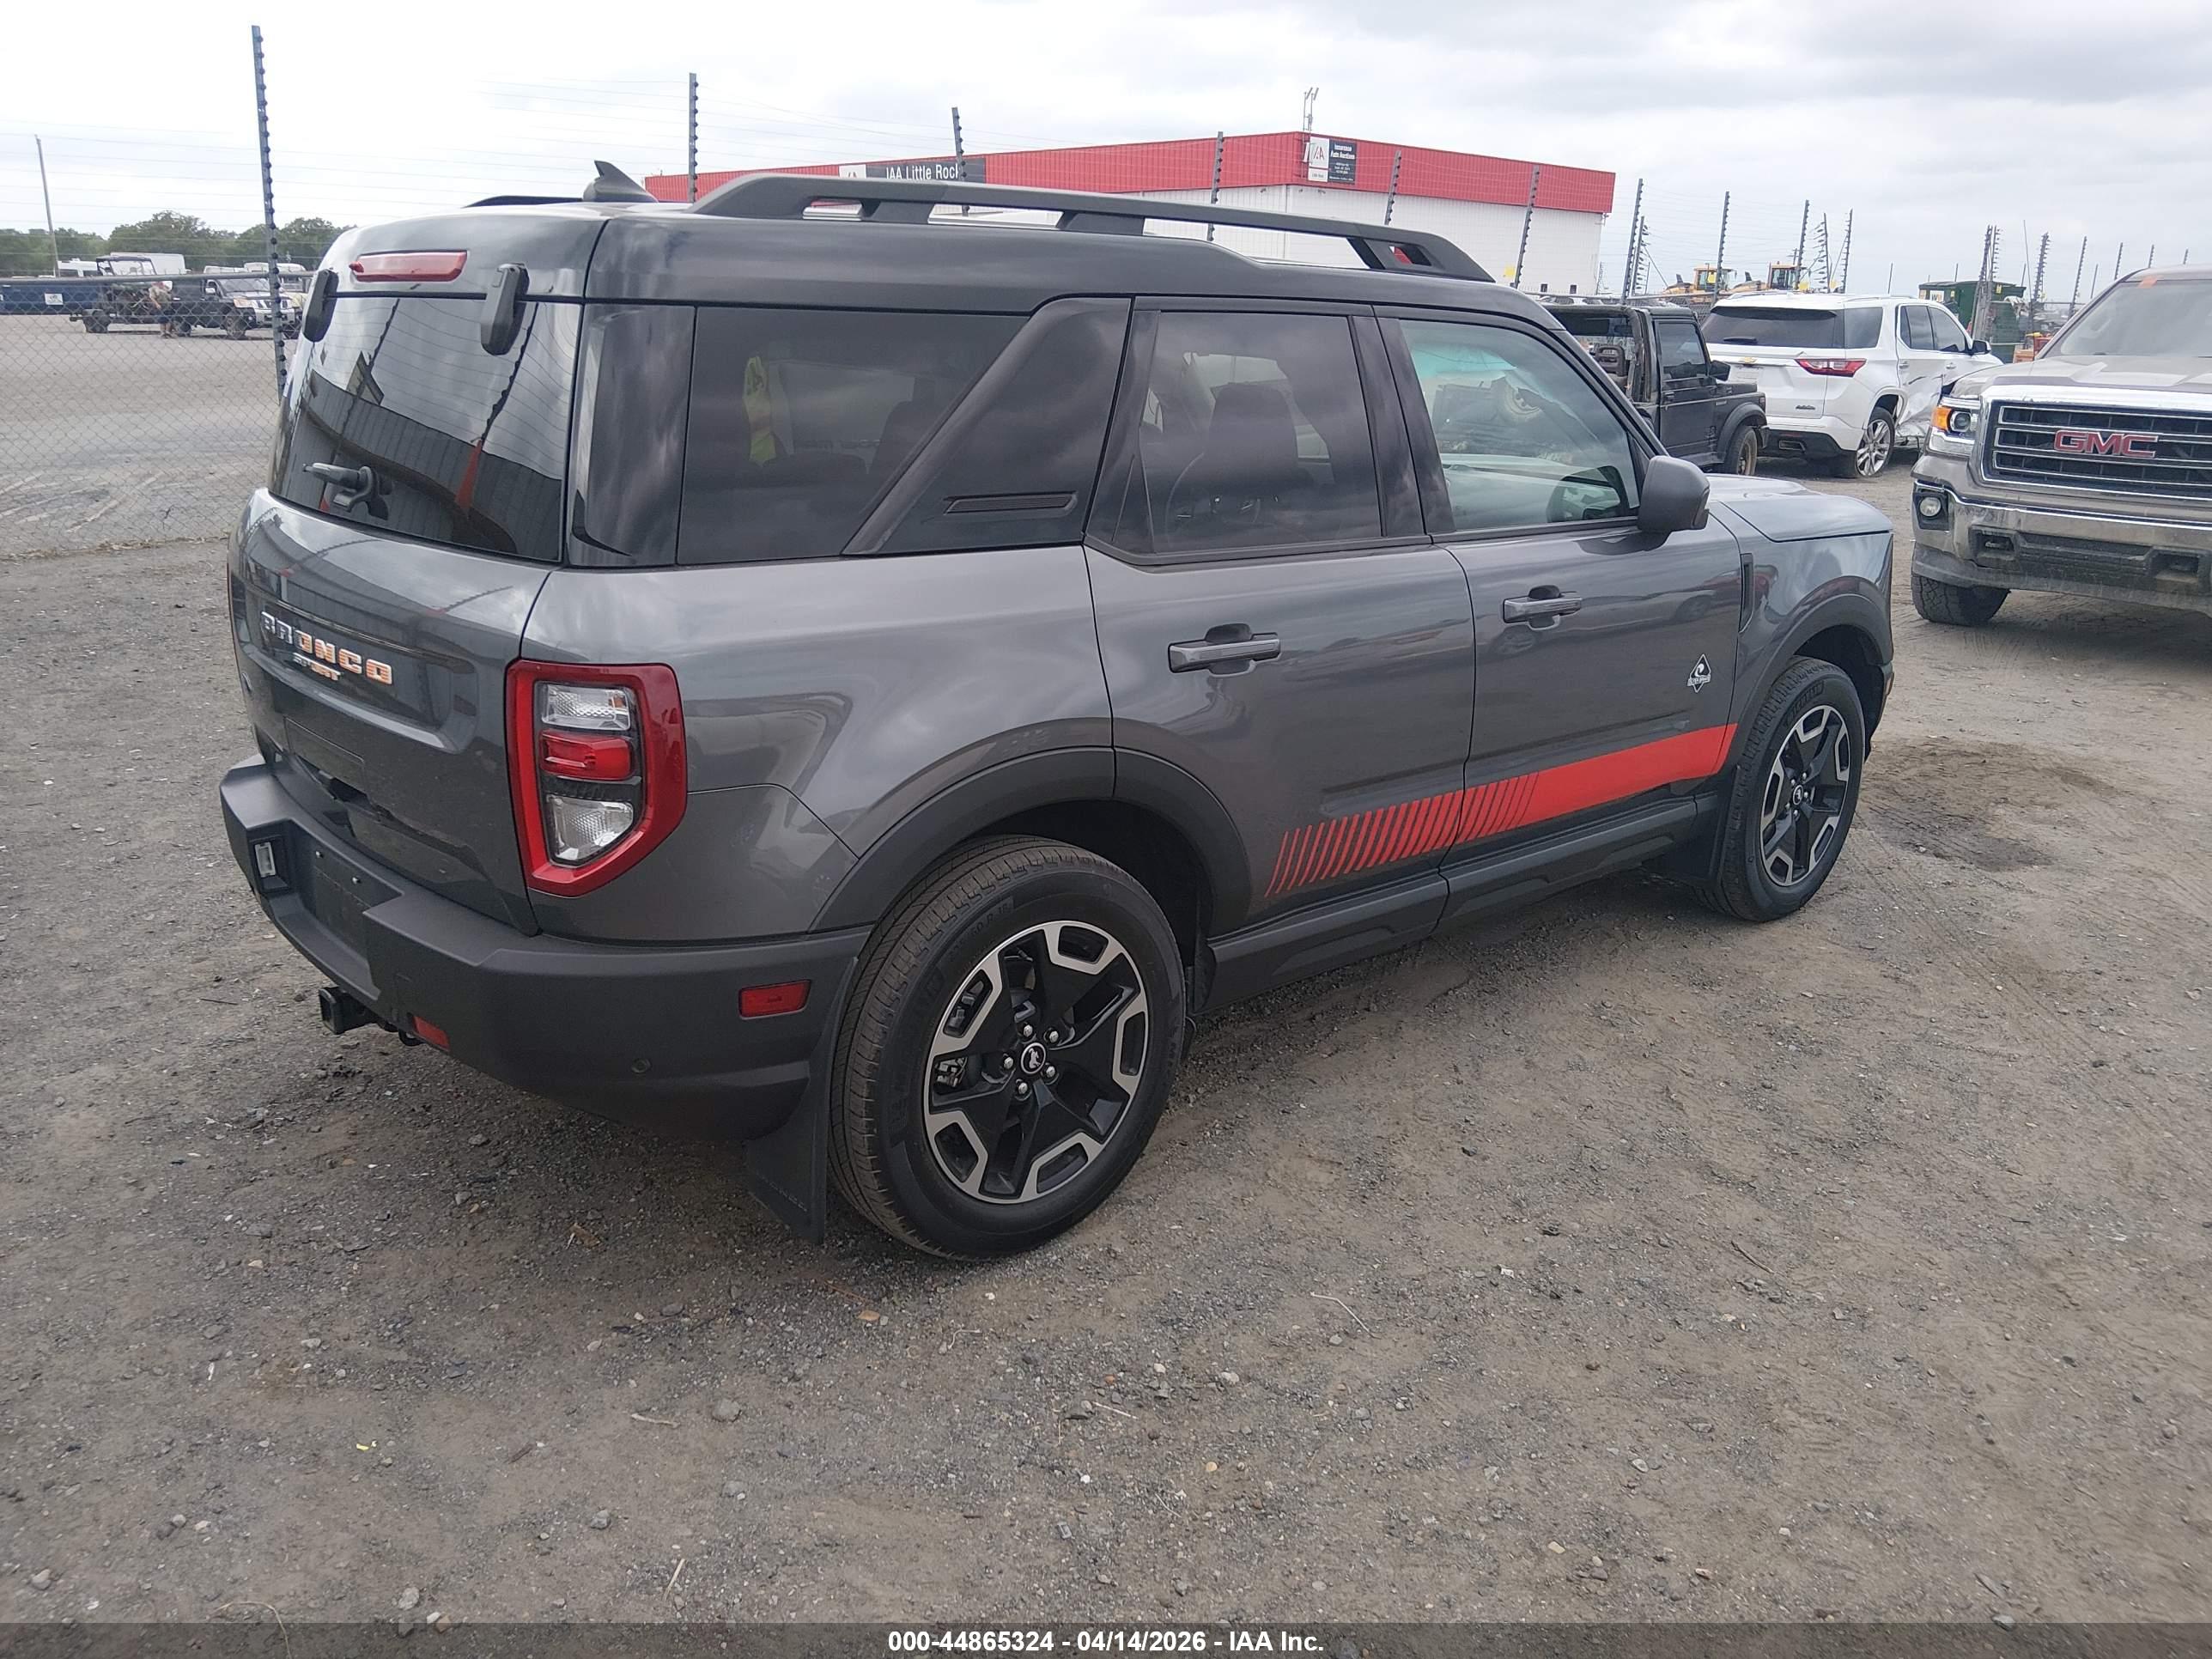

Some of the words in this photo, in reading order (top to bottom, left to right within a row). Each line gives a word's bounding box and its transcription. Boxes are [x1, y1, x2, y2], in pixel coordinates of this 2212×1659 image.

[886, 167, 902, 179] IAA
[906, 165, 932, 180] Little
[2053, 429, 2159, 459] GMC
[261, 611, 393, 685] BRONCO
